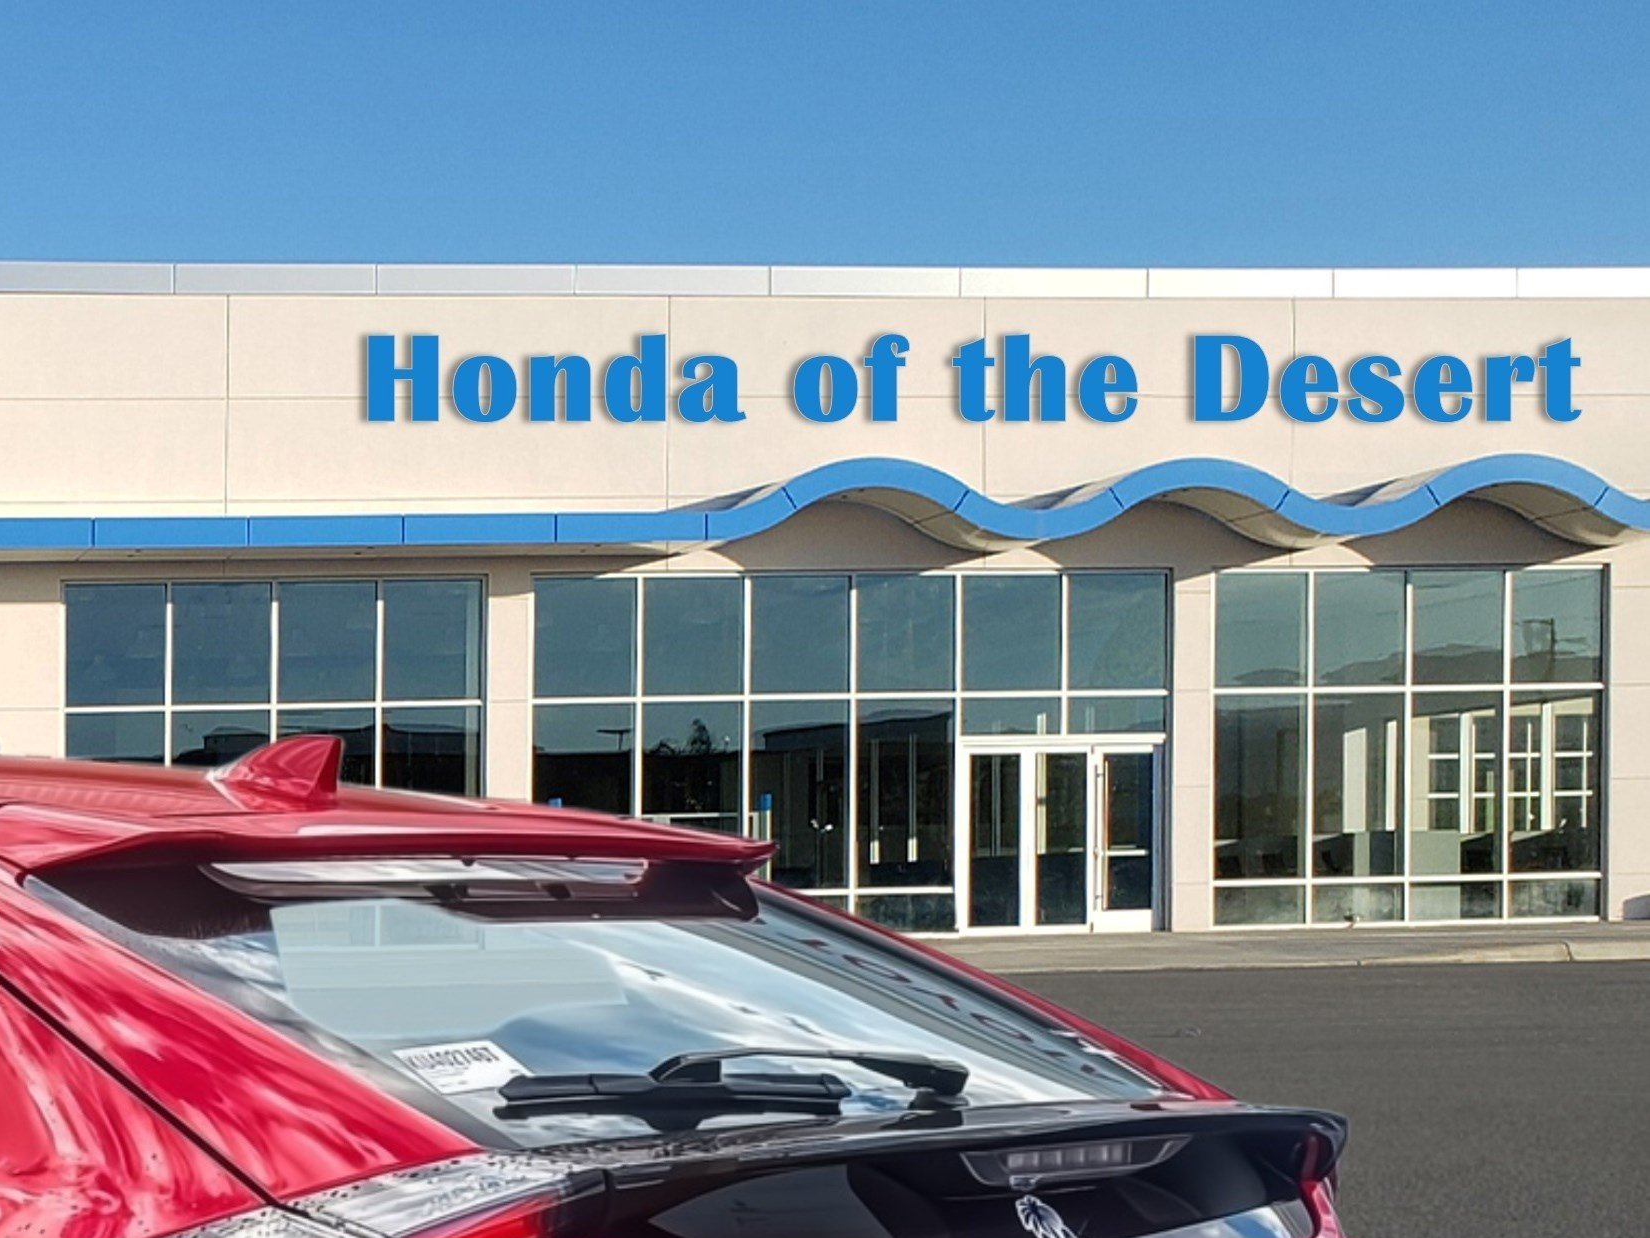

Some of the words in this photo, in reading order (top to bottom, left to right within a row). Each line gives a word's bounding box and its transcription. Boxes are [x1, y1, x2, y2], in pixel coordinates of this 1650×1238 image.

[367, 334, 746, 423] Honda
[794, 333, 910, 423] of
[952, 334, 1138, 423] the
[1194, 335, 1581, 423] Desert
